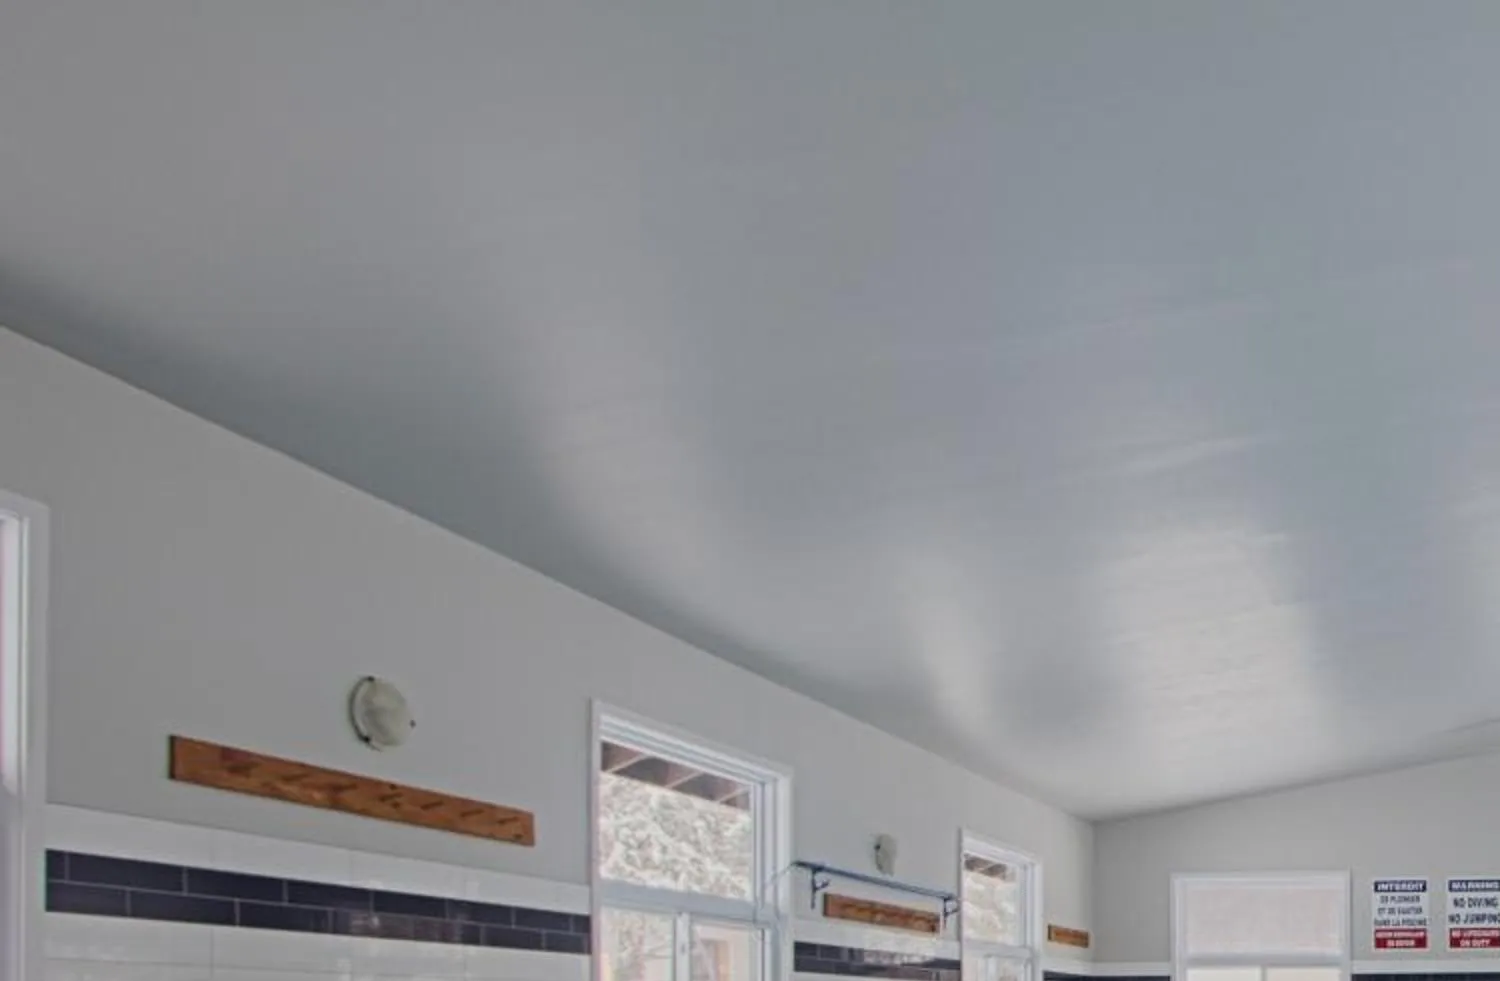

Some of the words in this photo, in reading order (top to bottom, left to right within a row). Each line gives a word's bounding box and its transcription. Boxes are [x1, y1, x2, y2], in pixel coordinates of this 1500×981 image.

[1453, 897, 1466, 908] NO
[1468, 897, 1499, 908] DIVING
[1448, 913, 1461, 924] NO
